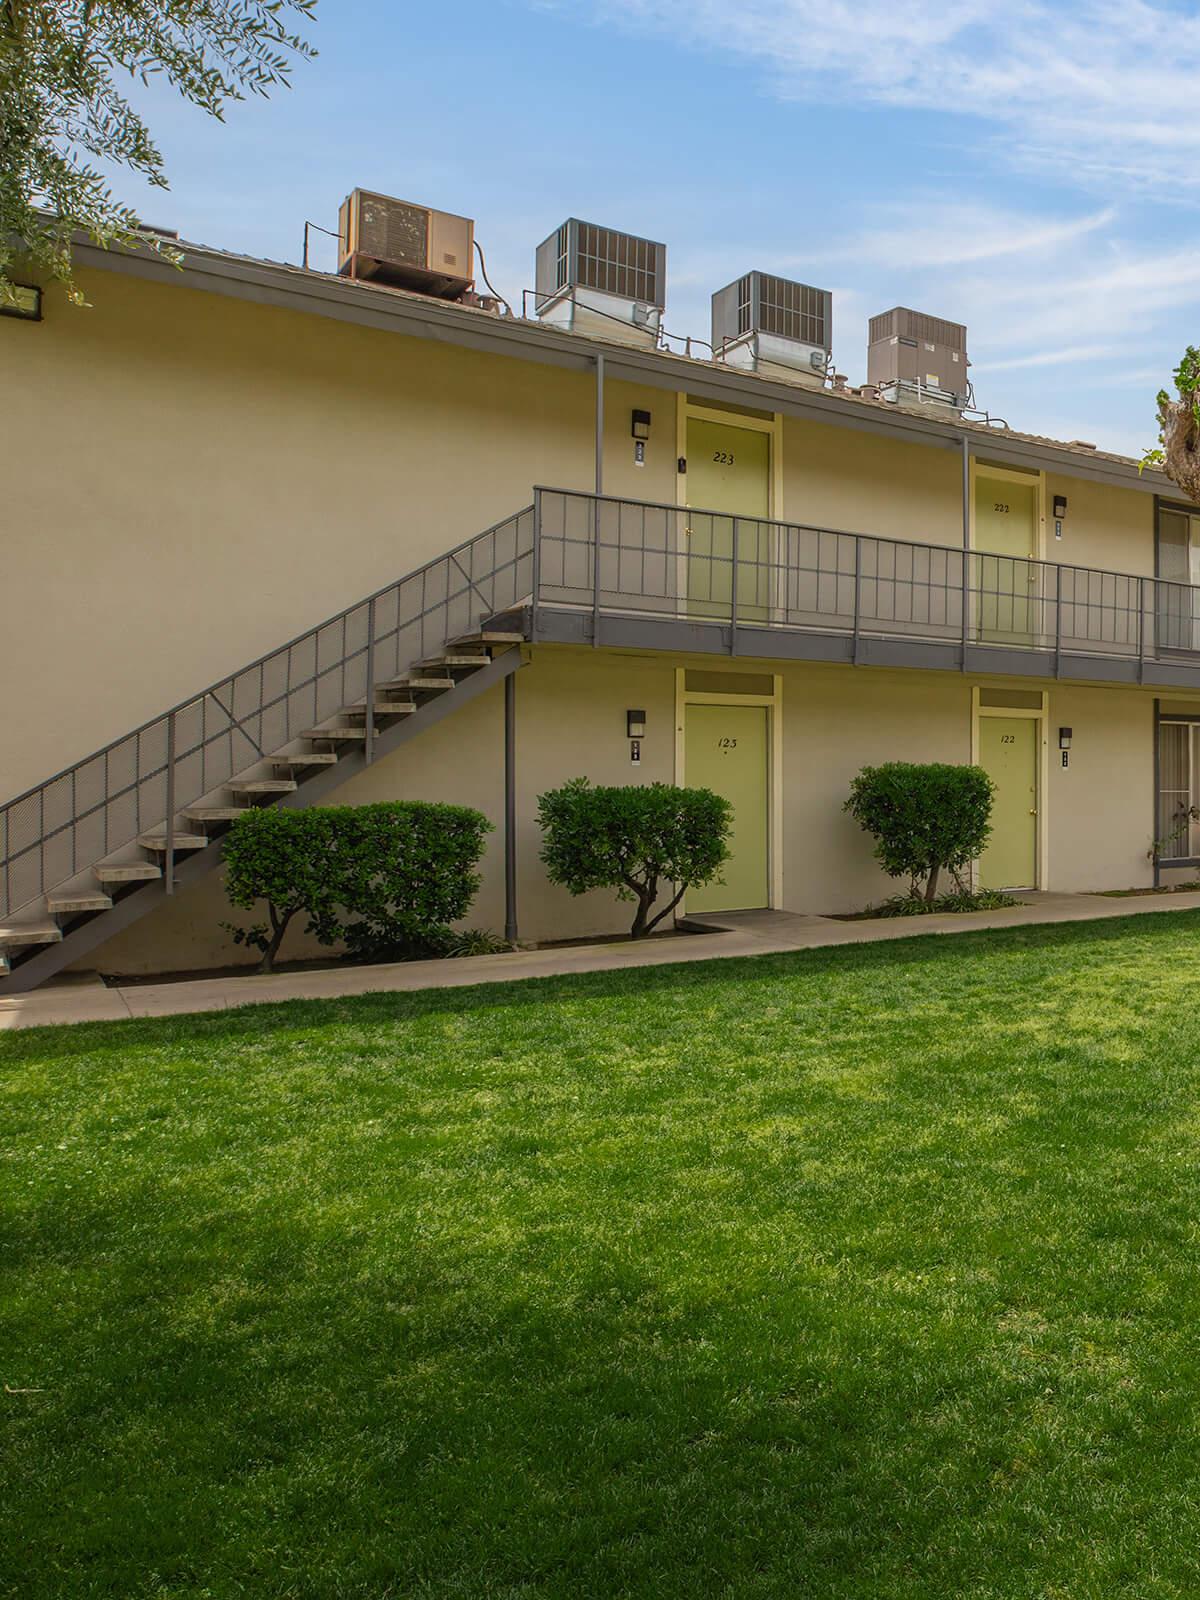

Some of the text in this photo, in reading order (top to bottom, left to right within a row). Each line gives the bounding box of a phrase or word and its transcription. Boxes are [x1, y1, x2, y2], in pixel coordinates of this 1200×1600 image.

[713, 451, 734, 466] 223
[994, 503, 1010, 513] 222
[1001, 735, 1015, 744] 122
